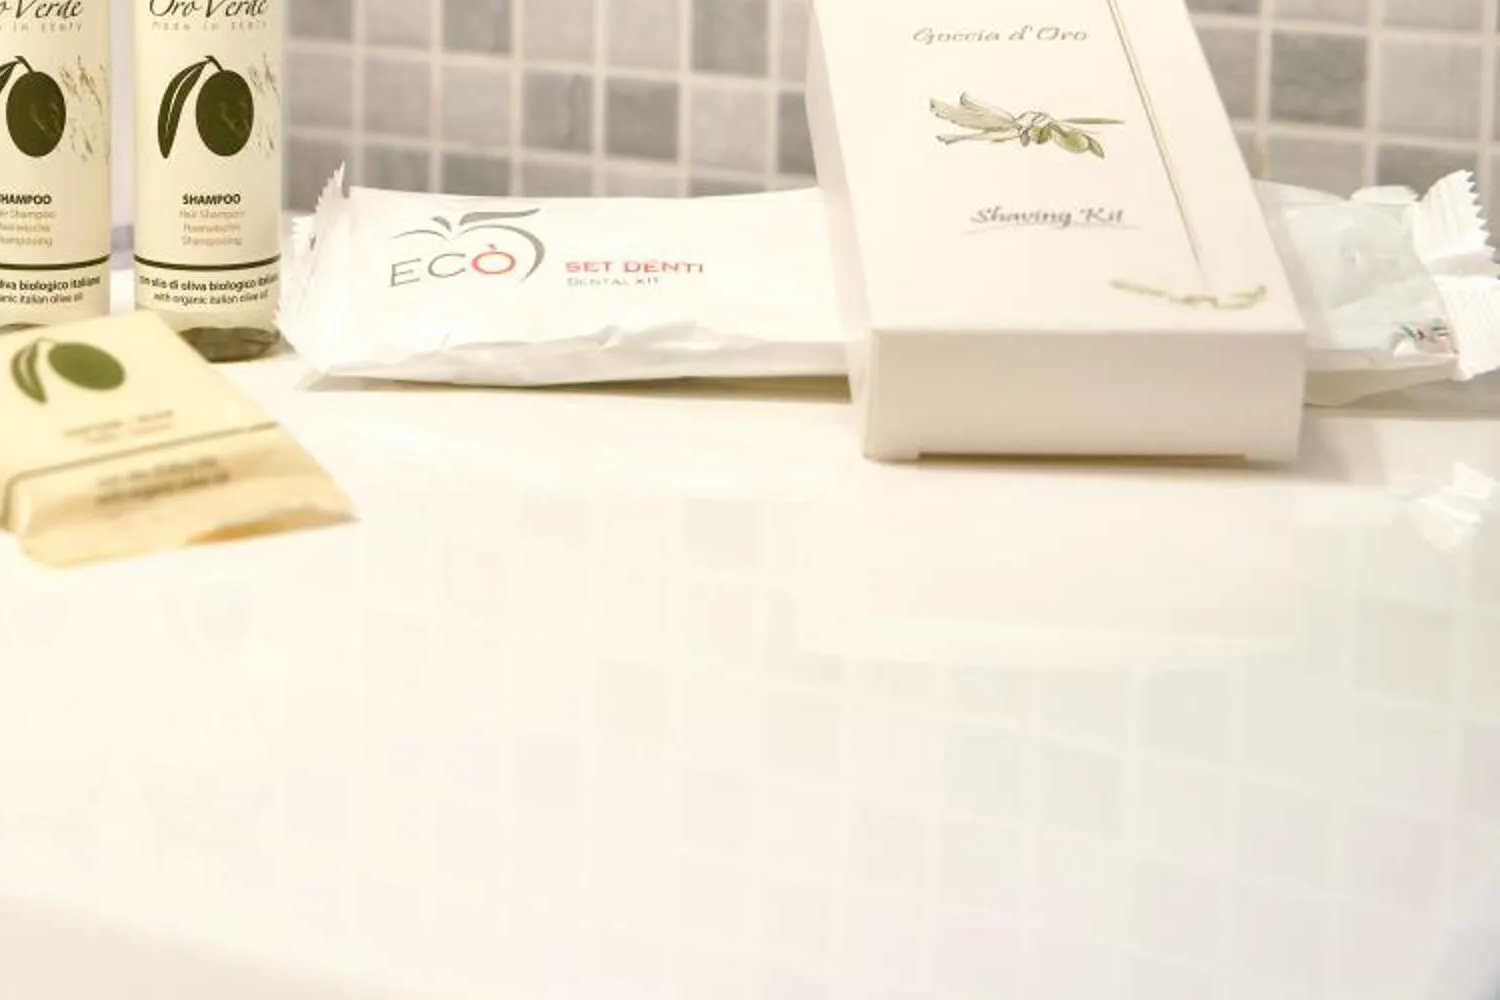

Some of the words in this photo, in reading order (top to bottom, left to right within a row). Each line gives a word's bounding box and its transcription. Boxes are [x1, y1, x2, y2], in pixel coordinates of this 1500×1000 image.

[182, 192, 241, 205] SHAMPOO
[970, 205, 1073, 228] Shaving
[565, 261, 613, 273] SET
[624, 261, 703, 274] DENTI
[19, 279, 69, 293] biologico
[169, 278, 179, 290] di
[181, 280, 207, 291] oliva
[209, 279, 257, 293] biologico
[19, 292, 49, 305] italian
[172, 294, 207, 307] organic
[209, 293, 239, 305] italian
